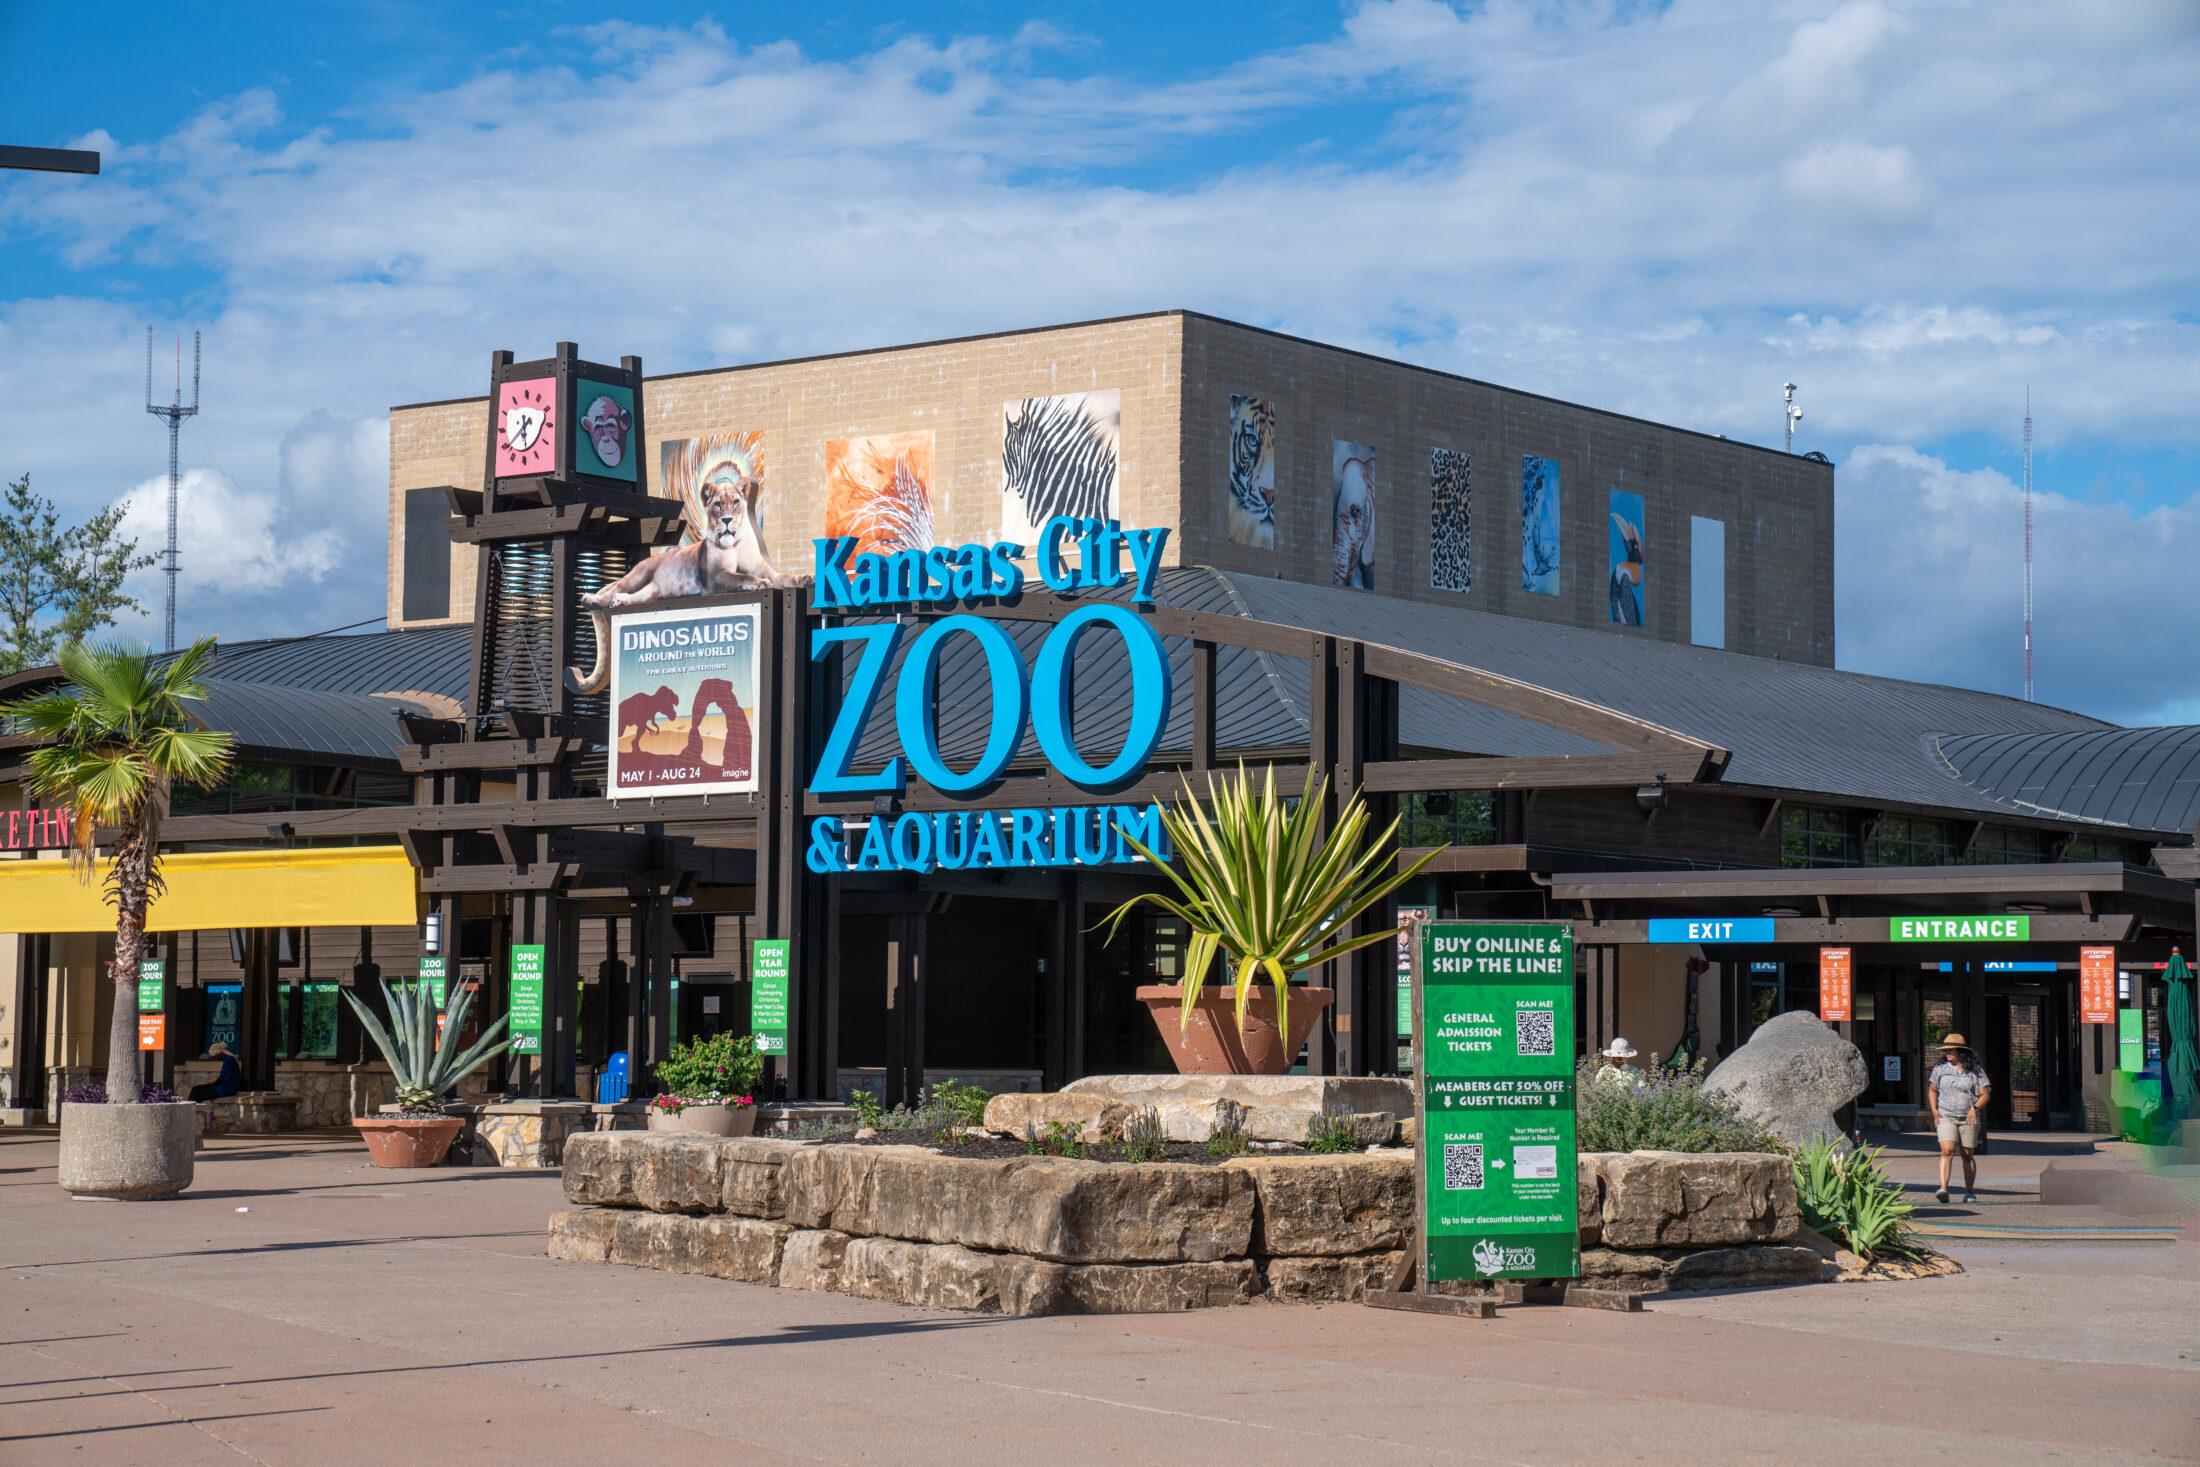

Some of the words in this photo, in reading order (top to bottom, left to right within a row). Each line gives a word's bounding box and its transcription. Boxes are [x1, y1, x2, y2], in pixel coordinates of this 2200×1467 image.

[811, 536, 1025, 609] Kansas
[1037, 515, 1172, 603] City
[624, 623, 749, 650] DINOSAURS
[639, 651, 683, 662] AROUND
[697, 646, 735, 658] WORLD
[662, 666, 688, 674] GREAT
[688, 663, 728, 672] OUTDOORS
[809, 604, 1172, 793] ZOO
[621, 771, 645, 782] MAY
[689, 767, 701, 778] 24
[722, 768, 749, 778] imagine
[806, 815, 848, 874] &
[855, 805, 1172, 875] AQUARIUM
[1688, 923, 1733, 939] EXIT
[1901, 920, 2017, 938] ENTRANCE
[1434, 937, 1472, 953] BUY
[1475, 938, 1545, 953] ONLINE
[1548, 938, 1562, 954] &
[517, 953, 538, 961] OPEN
[760, 949, 783, 957] OPEN
[143, 963, 159, 971] ZOO
[424, 960, 442, 968] ZOO
[760, 959, 782, 967] YEAR
[1432, 957, 1473, 973] SKIP
[1476, 958, 1512, 973] THE
[1516, 958, 1562, 973] LINE!
[420, 969, 445, 977] HOURS
[512, 972, 542, 980] ROUND
[755, 969, 787, 978] ROUND
[1516, 1000, 1537, 1008] SCAN
[1538, 1000, 1553, 1008] ME!
[1443, 1013, 1495, 1023] GENERAL
[212, 1031, 235, 1043] ZOO
[1436, 1027, 1502, 1038] ADMISSION
[1447, 1041, 1492, 1052] TICKETS
[1435, 1081, 1492, 1092] MEMBERS
[1493, 1081, 1514, 1091] GET
[1517, 1081, 1542, 1091] 50%
[1543, 1080, 1564, 1091] OFF
[1459, 1095, 1494, 1106] GUEST
[1496, 1095, 1542, 1106] TICKETS!
[1442, 1217, 1451, 1226] Up
[1460, 1216, 1475, 1224] four
[1476, 1216, 1512, 1224] discounted
[1536, 1216, 1548, 1224] per
[1524, 1246, 1536, 1254] City
[1506, 1254, 1536, 1266] ZOO
